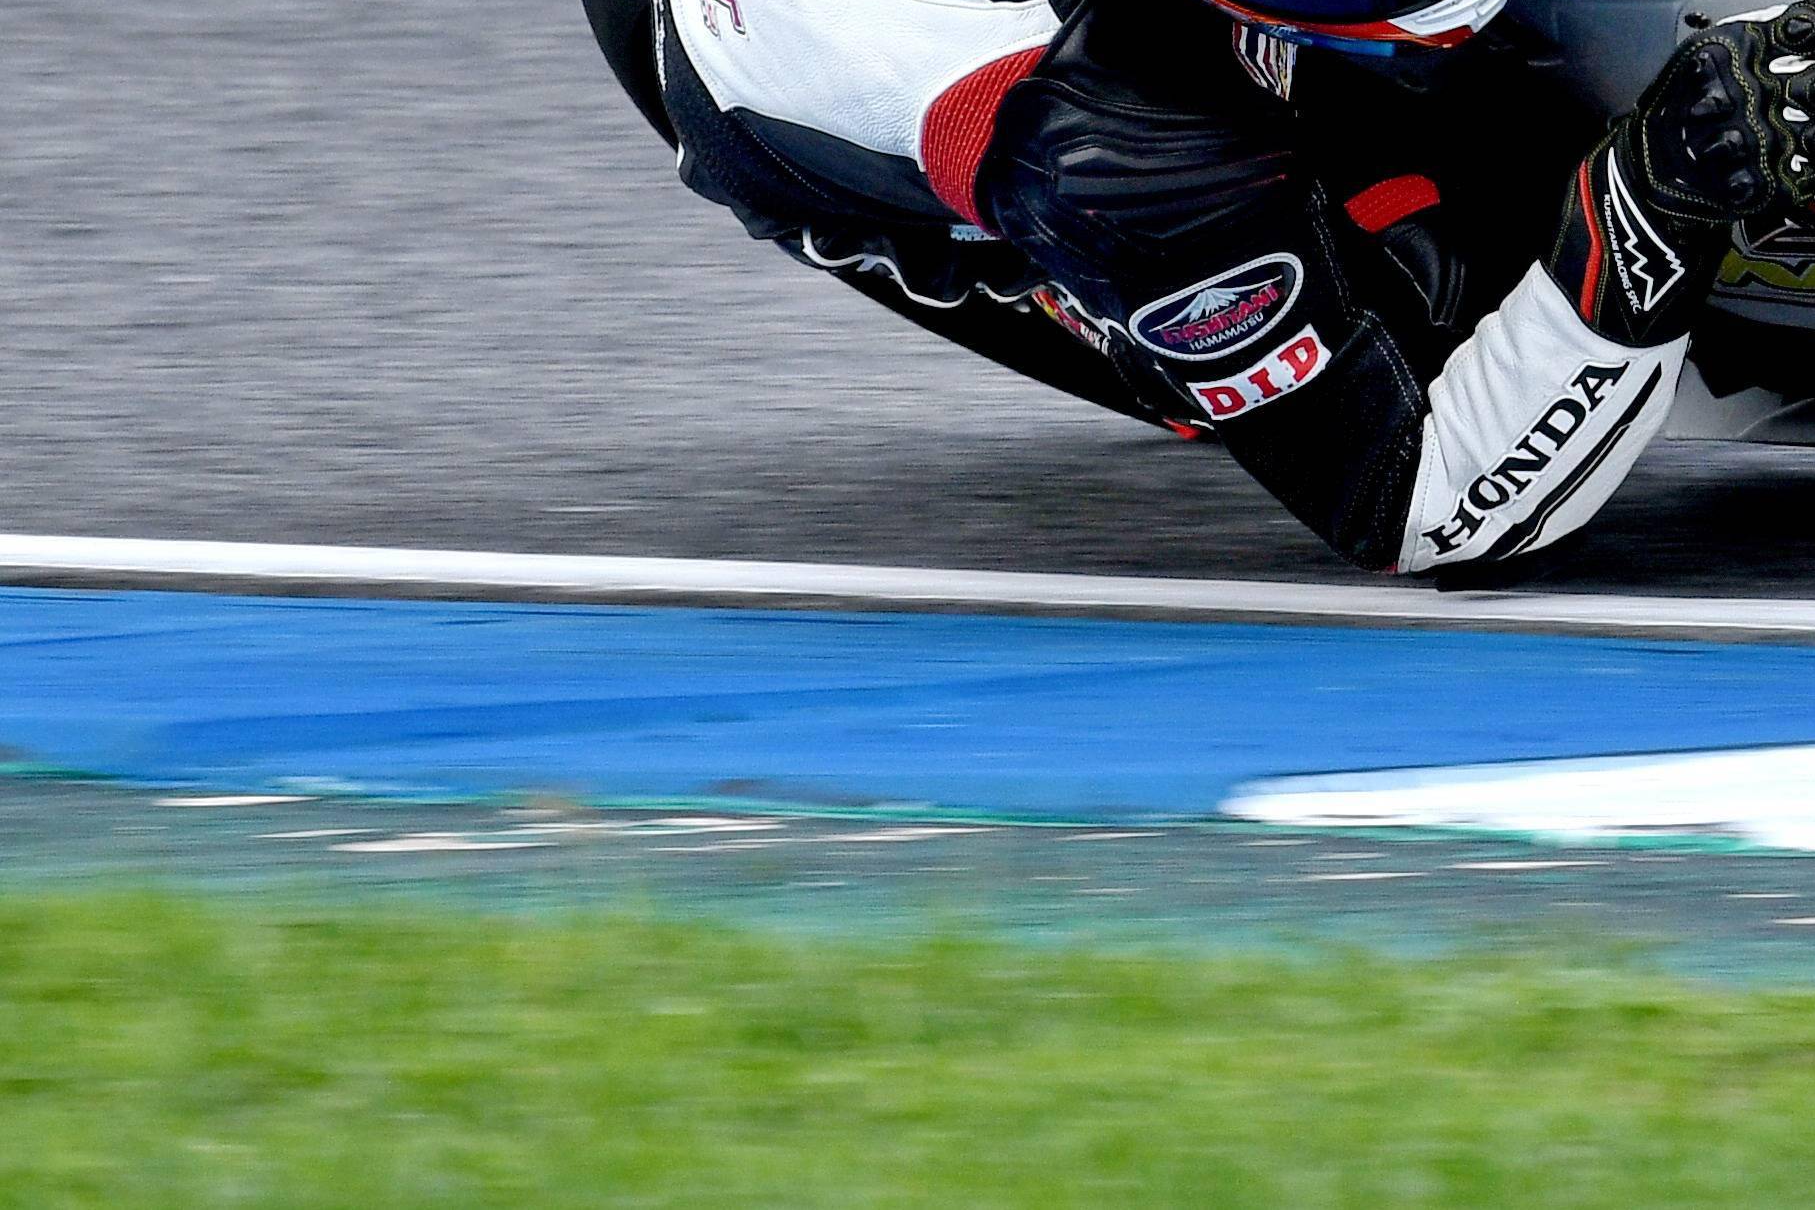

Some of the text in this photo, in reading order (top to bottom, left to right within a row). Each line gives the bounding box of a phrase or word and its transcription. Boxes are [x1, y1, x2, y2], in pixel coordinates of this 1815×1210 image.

[1613, 252, 1632, 289] RACING
[1190, 312, 1264, 352] HAMAMATSU
[1422, 360, 1631, 556] HONDA
